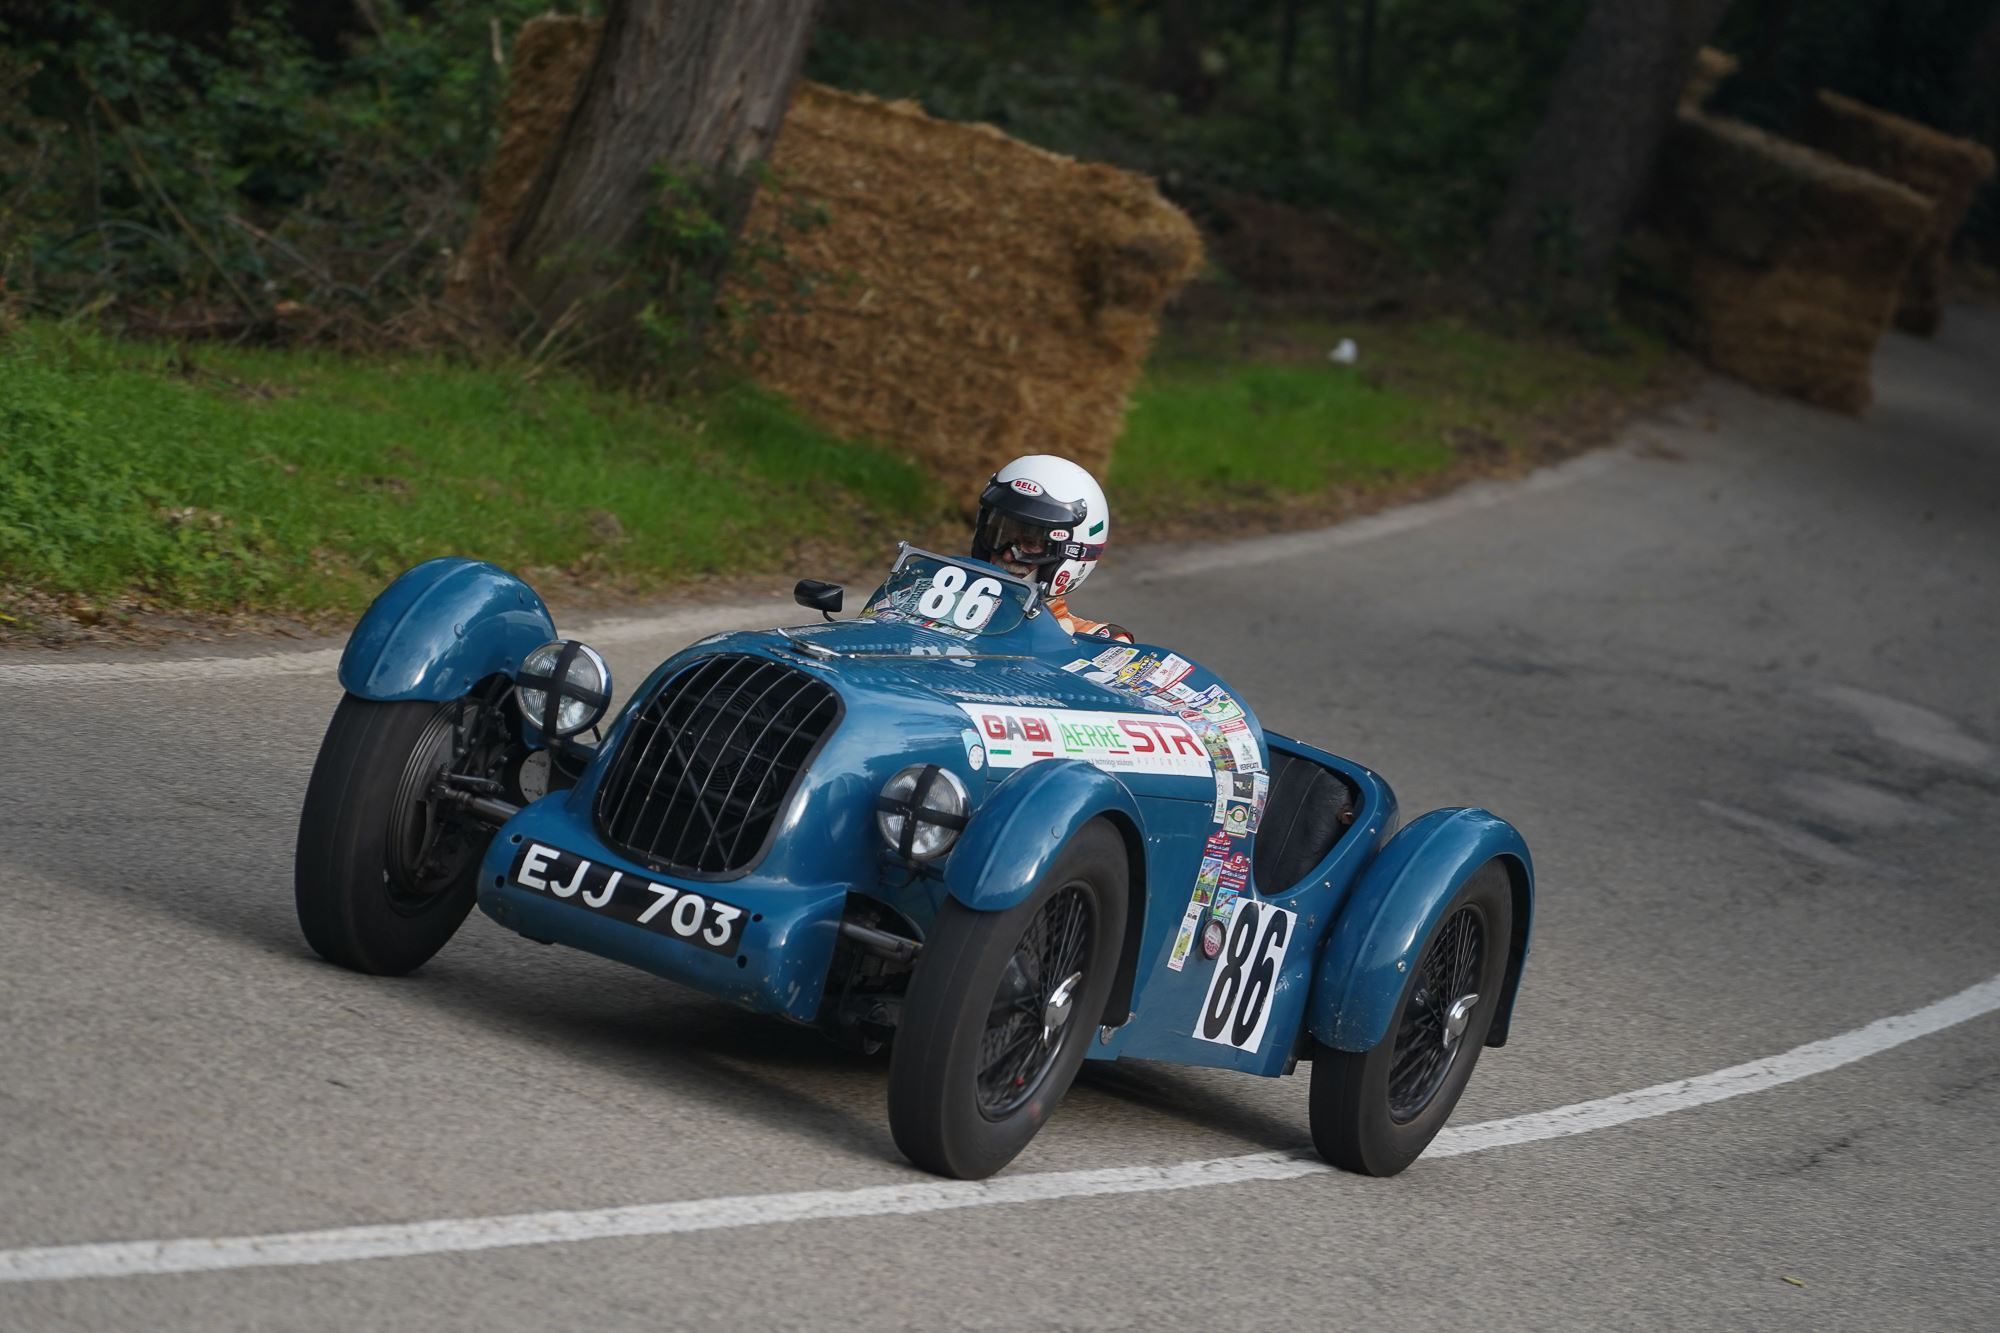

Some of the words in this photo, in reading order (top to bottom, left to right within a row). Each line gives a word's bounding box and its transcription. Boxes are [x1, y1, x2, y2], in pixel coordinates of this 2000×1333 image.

[1014, 480, 1038, 493] BELL
[1052, 531, 1067, 539] BELL
[918, 566, 1002, 630] 86
[981, 714, 1052, 743] GABI
[1064, 722, 1127, 749] AERRE
[1117, 719, 1204, 757] STR
[517, 843, 623, 908] EJJ
[636, 882, 741, 946] 703
[1203, 901, 1287, 1047] 86
